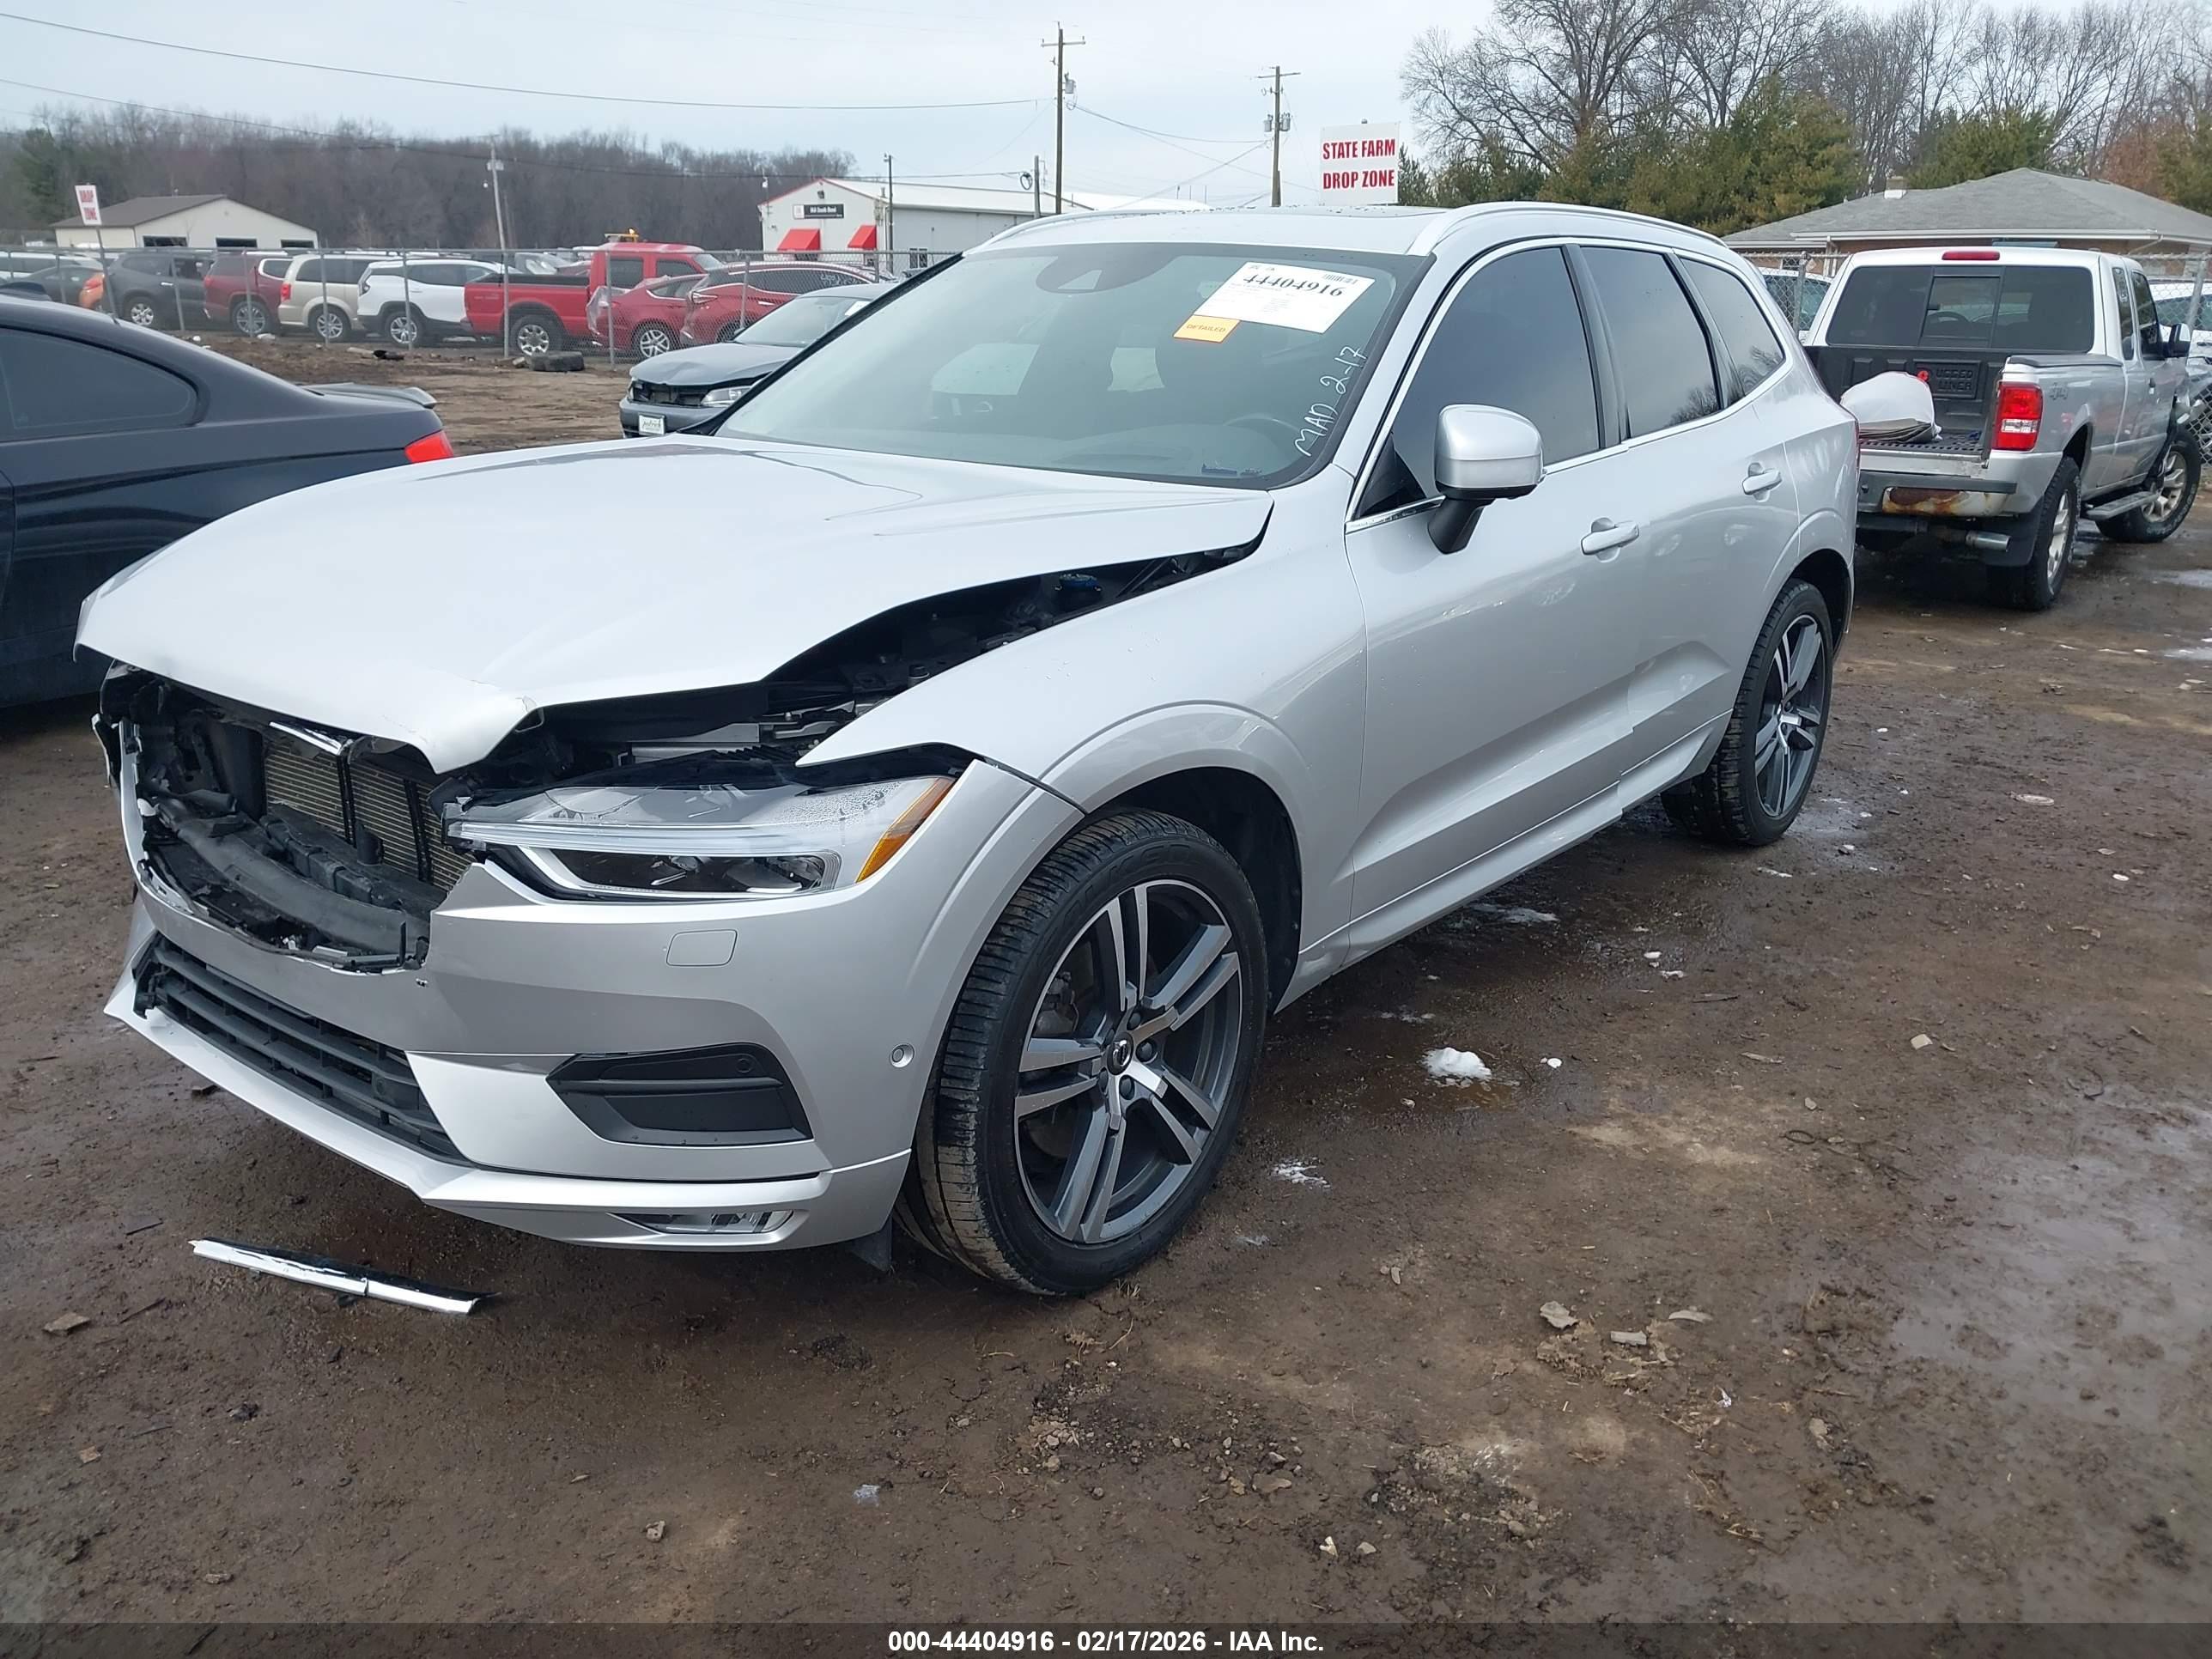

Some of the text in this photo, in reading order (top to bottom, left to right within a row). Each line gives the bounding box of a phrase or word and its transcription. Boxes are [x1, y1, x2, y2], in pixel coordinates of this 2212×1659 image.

[1322, 138, 1395, 160] STATE FARM
[1323, 169, 1395, 190] DROP ZONE
[1243, 273, 1347, 297] 44404916
[1185, 323, 1227, 333] DETAILED
[1320, 346, 1367, 394] 2-17
